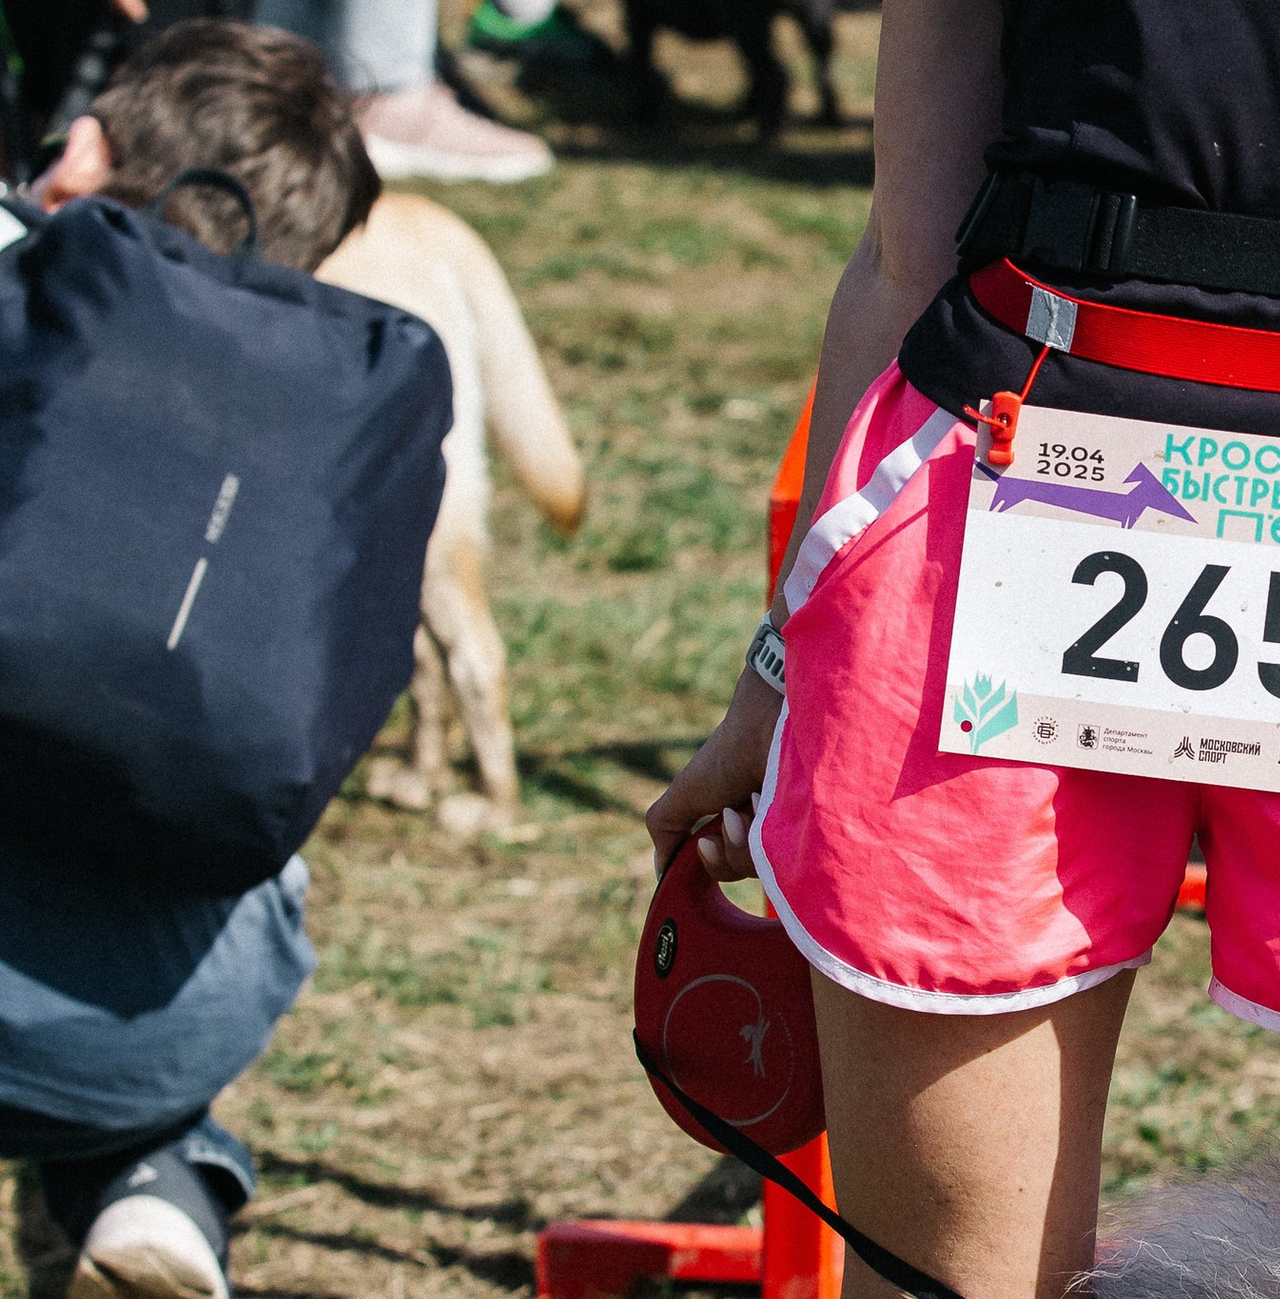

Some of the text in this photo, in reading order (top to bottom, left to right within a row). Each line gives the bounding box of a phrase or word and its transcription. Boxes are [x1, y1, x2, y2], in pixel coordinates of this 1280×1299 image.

[1038, 442, 1105, 464] 19.04
[1036, 459, 1105, 482] 2025
[1103, 727, 1148, 739] Департамент
[1103, 736, 1127, 745] спорта
[1199, 737, 1261, 756] МОСКОВСКИЙ
[1102, 744, 1153, 755] города Москвы
[1198, 750, 1228, 764] СПОРТ
